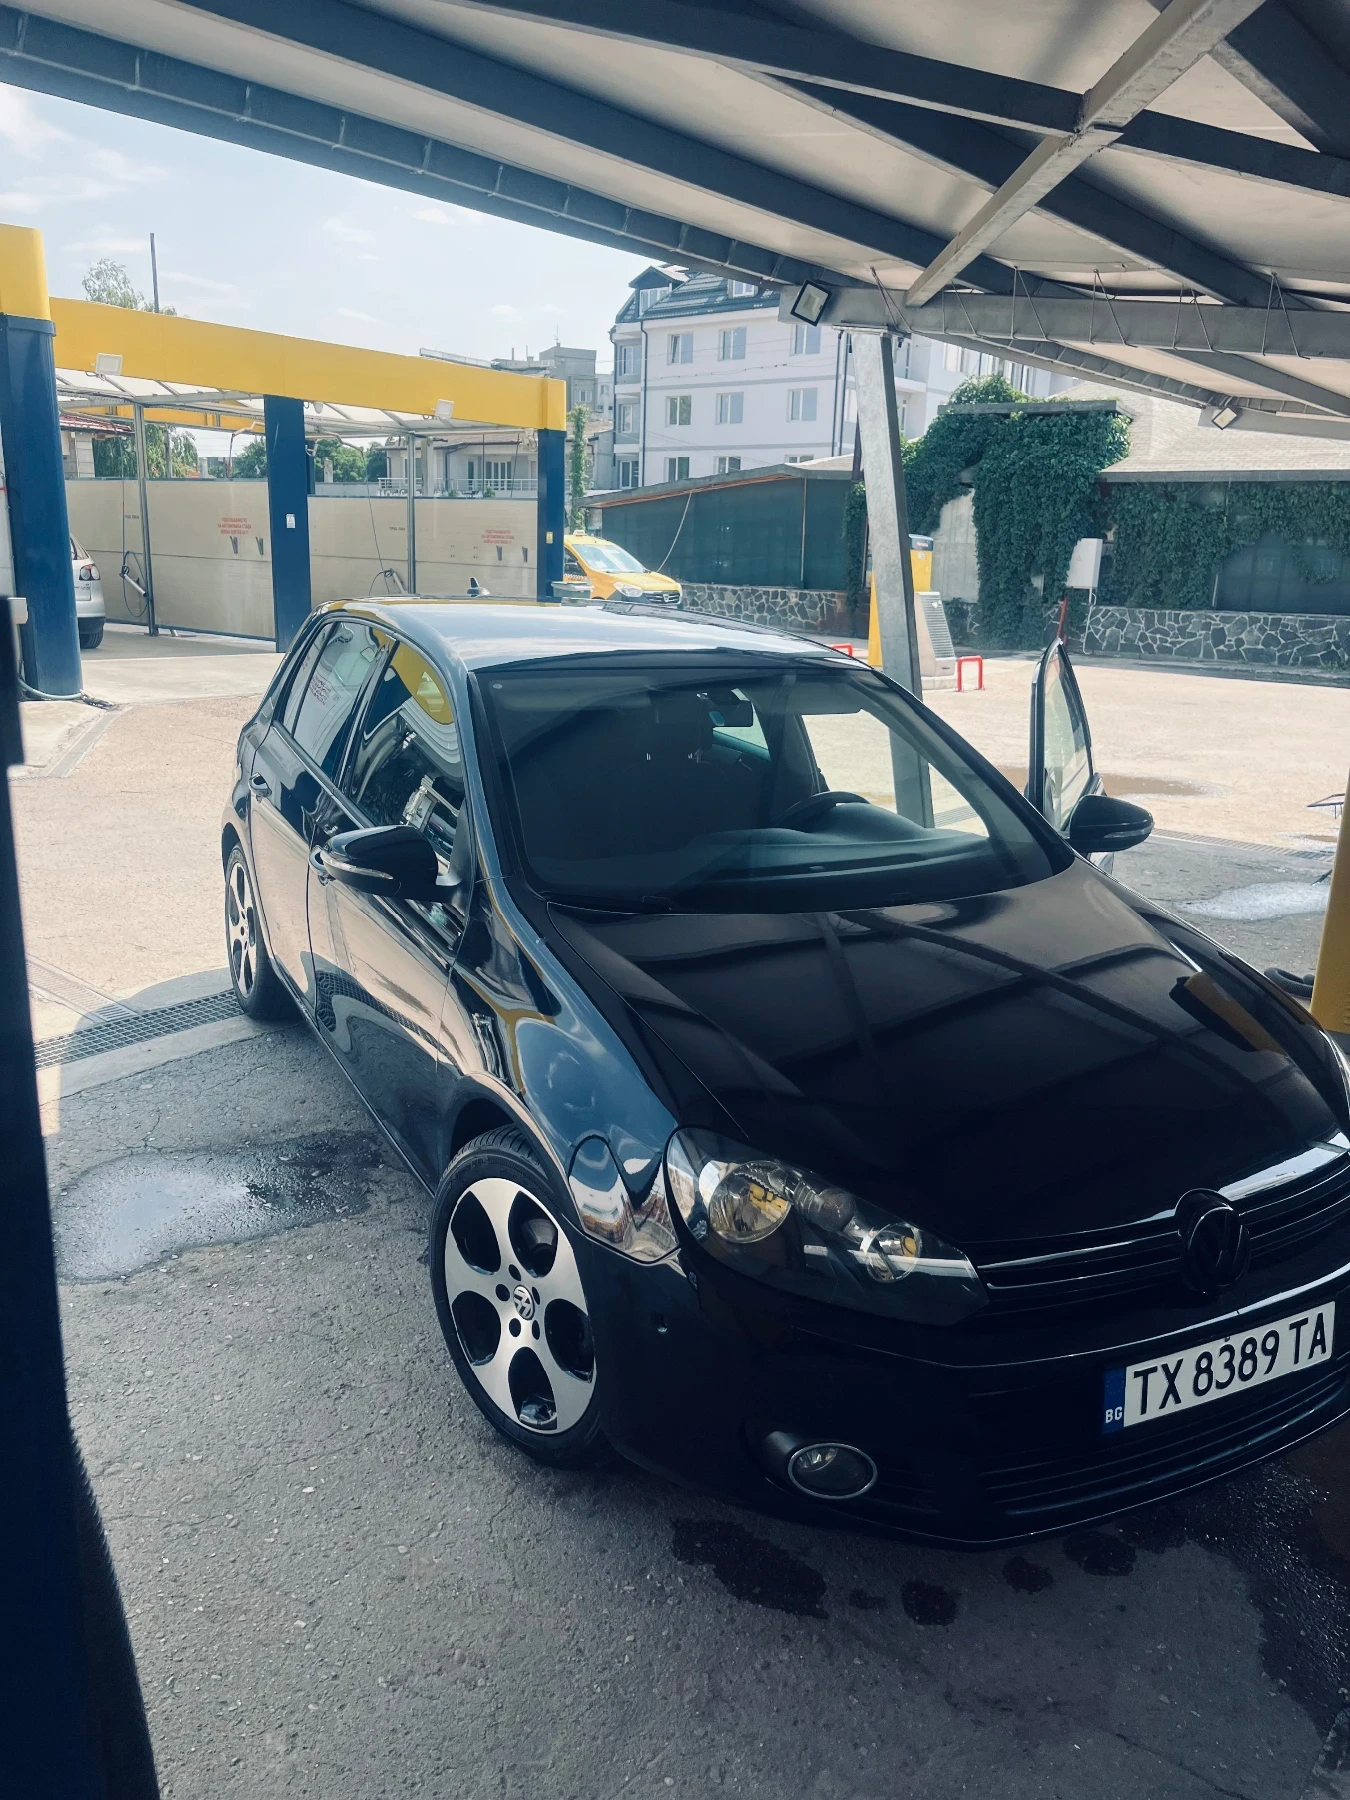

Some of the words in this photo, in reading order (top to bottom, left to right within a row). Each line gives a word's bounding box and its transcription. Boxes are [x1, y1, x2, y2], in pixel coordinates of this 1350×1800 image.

[1133, 1358, 1184, 1416] TX
[1192, 1329, 1280, 1398] 8389
[1288, 1312, 1327, 1365] TA
[1105, 1406, 1123, 1424] BG
